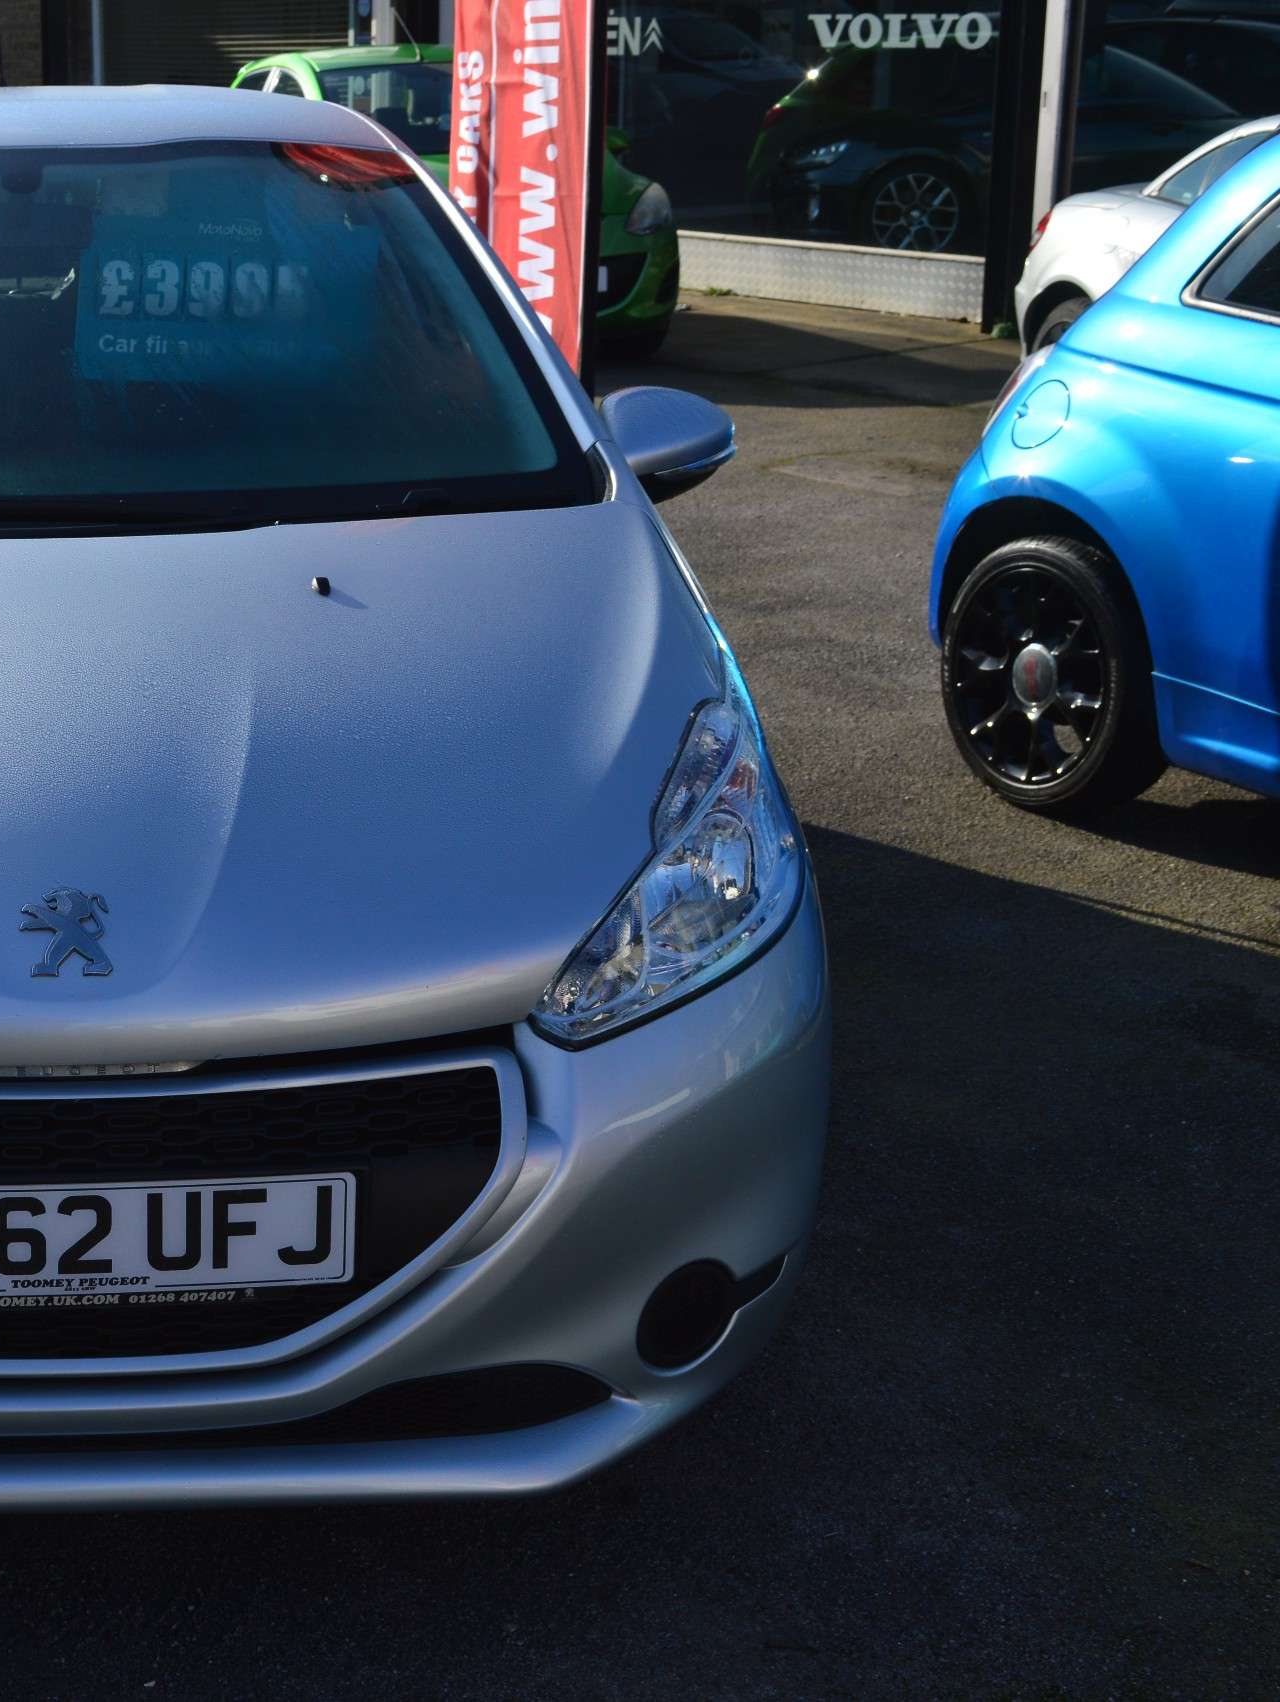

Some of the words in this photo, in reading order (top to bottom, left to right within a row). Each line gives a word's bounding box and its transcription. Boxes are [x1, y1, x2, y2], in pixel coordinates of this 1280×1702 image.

[808, 12, 992, 50] VOLVO
[456, 51, 485, 173] CARS
[513, 0, 560, 335] ww.win
[98, 334, 137, 354] Car
[146, 1185, 333, 1272] UFJ
[10, 1278, 76, 1289] TOOMEY
[78, 1276, 151, 1288] PEUGEOT
[128, 1292, 176, 1304] 01268
[179, 1290, 236, 1303] 407407
